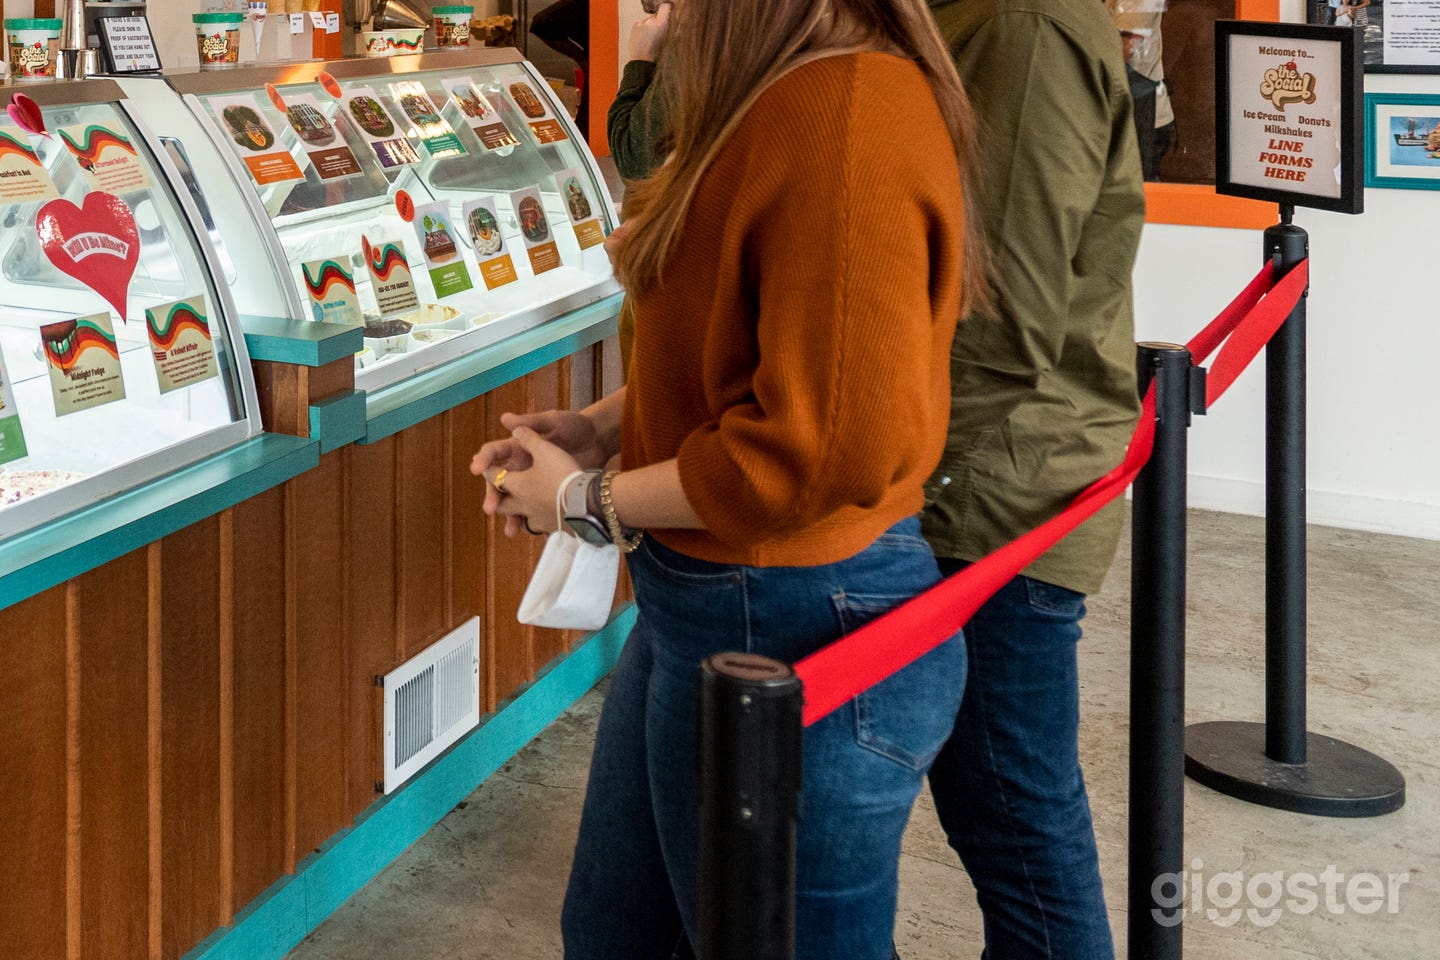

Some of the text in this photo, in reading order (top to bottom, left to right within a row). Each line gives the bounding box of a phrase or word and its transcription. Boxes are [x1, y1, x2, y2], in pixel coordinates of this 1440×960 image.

[20, 49, 49, 68] Social
[1259, 46, 1296, 57] Welcome
[1278, 65, 1296, 78] the
[1261, 68, 1311, 96] Social
[1243, 110, 1331, 127] Ice Cream Donuts
[1264, 125, 1313, 138] Milkshakes
[1268, 139, 1303, 153] LINE
[1258, 152, 1313, 168] FORMS
[1264, 167, 1306, 182] HERE
